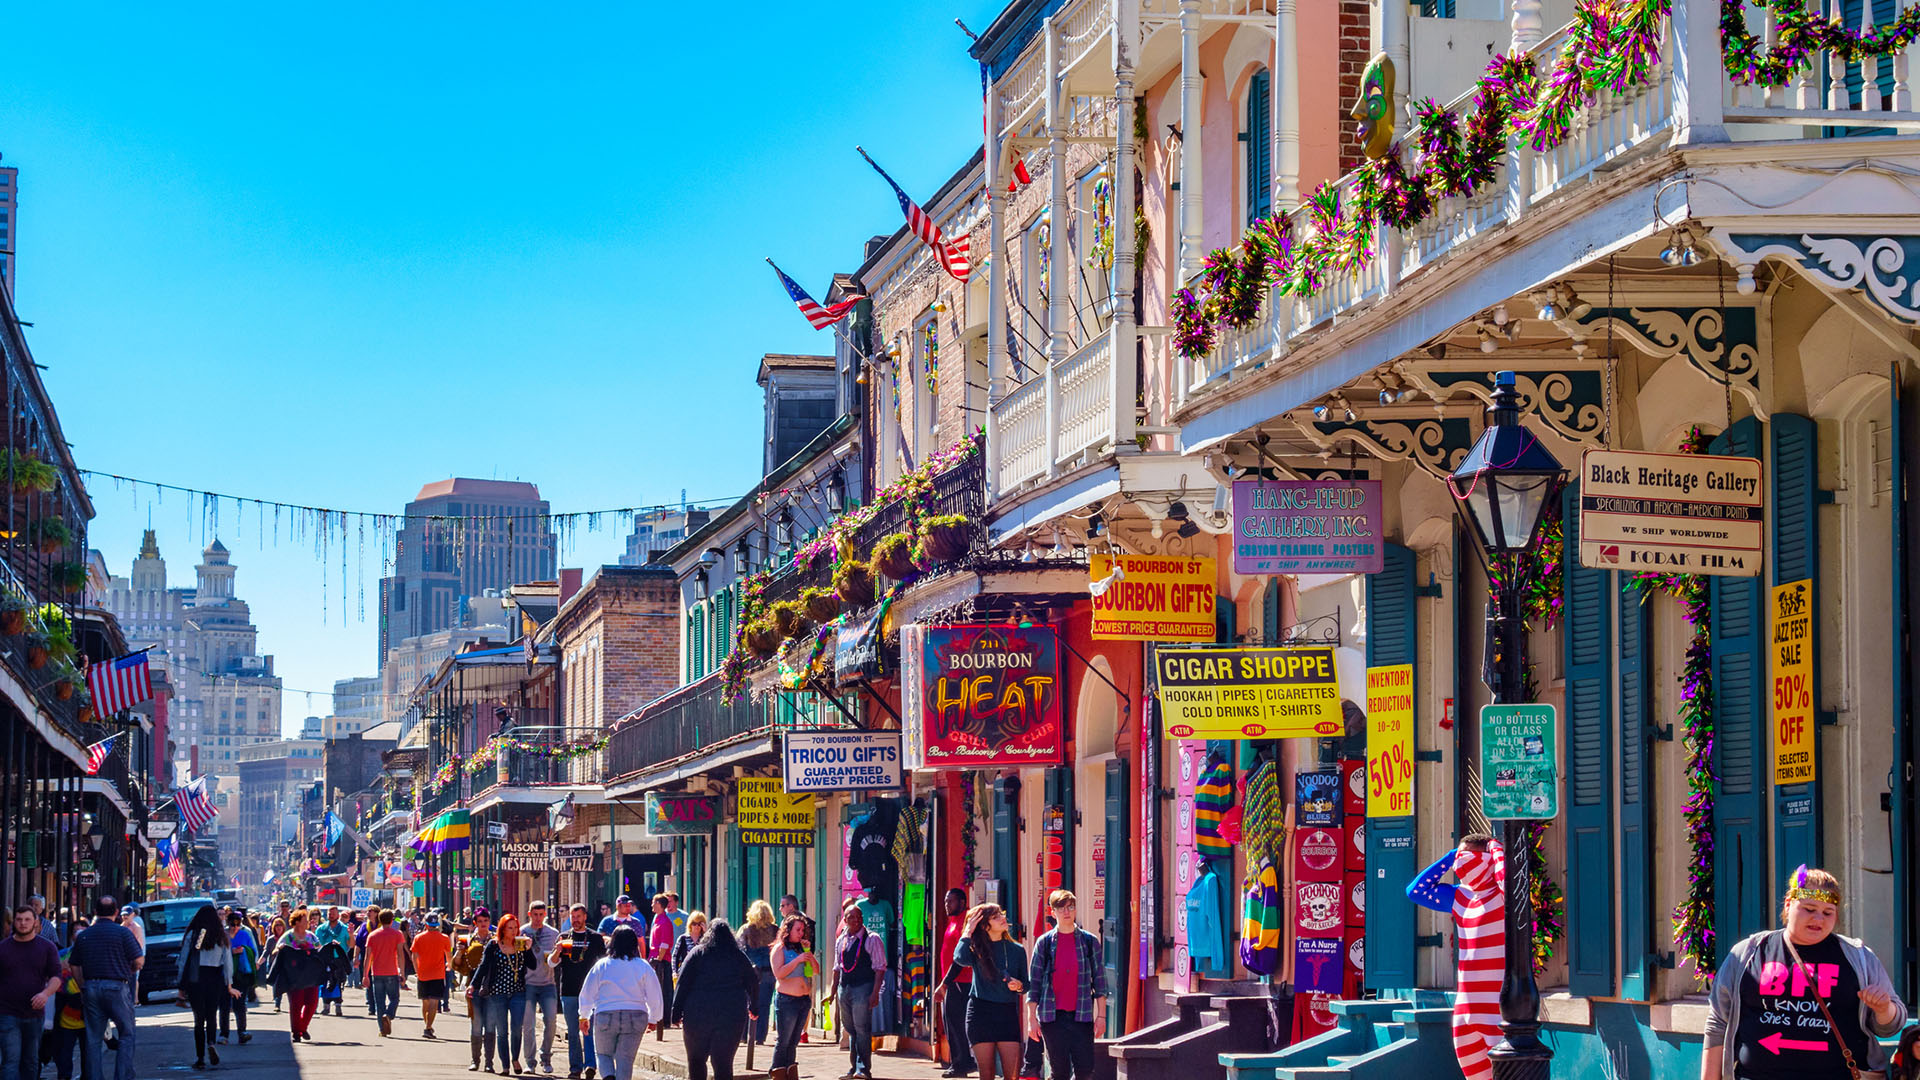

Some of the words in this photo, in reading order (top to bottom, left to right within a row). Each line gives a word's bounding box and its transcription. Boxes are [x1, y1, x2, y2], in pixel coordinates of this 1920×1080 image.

[1591, 464, 1630, 485] Black
[1638, 467, 1698, 494] Heritage
[1706, 471, 1757, 497] Gallery
[1252, 487, 1365, 509] HANG-IT-UP
[1596, 498, 1640, 513] SPECIALIZING
[1643, 501, 1651, 512] IN
[1654, 501, 1722, 518] AFRICAN-AMERICAN
[1726, 506, 1749, 519] PRINTS
[1241, 515, 1330, 539] GALLERY,
[1333, 515, 1373, 537] INC.
[1622, 526, 1636, 534] WE
[1642, 527, 1665, 535] SHIP
[1670, 529, 1729, 539] WORLDWIDE
[1238, 544, 1277, 556] CUSTOM
[1281, 543, 1324, 556] FRAMING
[1333, 543, 1375, 556] POSTERS
[1127, 560, 1183, 574] BOURBON
[1187, 562, 1203, 574] ST
[1258, 561, 1271, 569] WE
[1278, 561, 1300, 569] SHIP
[1306, 560, 1356, 569] ANYWHERE
[1630, 550, 1692, 566] KODAK
[1701, 554, 1744, 569] FILM
[1171, 583, 1213, 613] GIFTS
[1094, 622, 1127, 633] LOWEST
[1130, 622, 1155, 634] PRICE
[1157, 623, 1214, 635] GUARANTEED
[1774, 621, 1790, 644] JAZZ
[1791, 617, 1808, 638] FEST
[979, 639, 999, 649] 711
[949, 652, 1032, 669] BOURBON
[1781, 644, 1801, 667] SALE
[1165, 658, 1234, 680] CIGAR
[1240, 655, 1330, 679] SHOPPE
[1368, 670, 1410, 689] INVENTORY
[1165, 690, 1212, 702] HOOKAH
[1223, 689, 1256, 701] PIPES
[1266, 687, 1336, 701] CIGARETTES
[1775, 673, 1809, 711] 50%
[936, 675, 1053, 735] HEAT
[1368, 693, 1411, 713] REDUCTION
[1183, 705, 1212, 718] COLD
[1217, 705, 1260, 718] DRINKS
[1270, 704, 1322, 717] T-SHIRTS
[1377, 720, 1400, 733] 10-20
[1489, 715, 1502, 724] NO
[1506, 714, 1547, 725] BOTTLES
[1022, 723, 1055, 744] CLUB
[1174, 727, 1190, 735] ATM
[1246, 726, 1262, 734] ATM
[1319, 724, 1335, 732] ATM
[1495, 726, 1507, 735] OR
[1511, 725, 1542, 735] GLASS
[1780, 716, 1804, 746] OFF
[827, 736, 861, 744] BOURBON
[864, 735, 874, 743] ST.
[950, 730, 989, 748] GRILL
[790, 747, 846, 763] TRICOU
[853, 746, 896, 762] GIFTS
[927, 745, 949, 757] Bar
[955, 745, 999, 758] Balcony
[1005, 745, 1054, 758] Courtyard
[1492, 748, 1505, 757] ON
[1778, 751, 1809, 766] SELECTED
[804, 766, 883, 777] GUARANTEED
[1369, 740, 1411, 798] 50%
[1777, 766, 1794, 780] ITEMS
[1795, 764, 1812, 778] ONLY
[740, 781, 784, 793] PREMIUM
[796, 776, 844, 787] LOWEST
[849, 775, 891, 785] PRICES
[1297, 774, 1338, 788] VOODOO
[740, 797, 778, 808] CIGARS
[1390, 792, 1411, 811] OFF
[658, 799, 714, 822] CATS
[1306, 813, 1331, 821] BLUES
[740, 813, 769, 824] PIPES
[773, 813, 779, 823] &
[782, 813, 811, 824] MORE
[741, 831, 812, 845] CIGARETTES
[569, 847, 590, 856] Peter
[1301, 847, 1337, 856] BOURBON
[571, 856, 594, 871] JAZZ
[1301, 884, 1338, 901] VOODOO
[1298, 940, 1310, 948] I'm
[1311, 940, 1316, 948] A
[1318, 940, 1337, 949] Nurse
[1759, 961, 1839, 998] BFF
[1760, 1011, 1791, 1026] She's
[1797, 1014, 1832, 1034] Crazy
